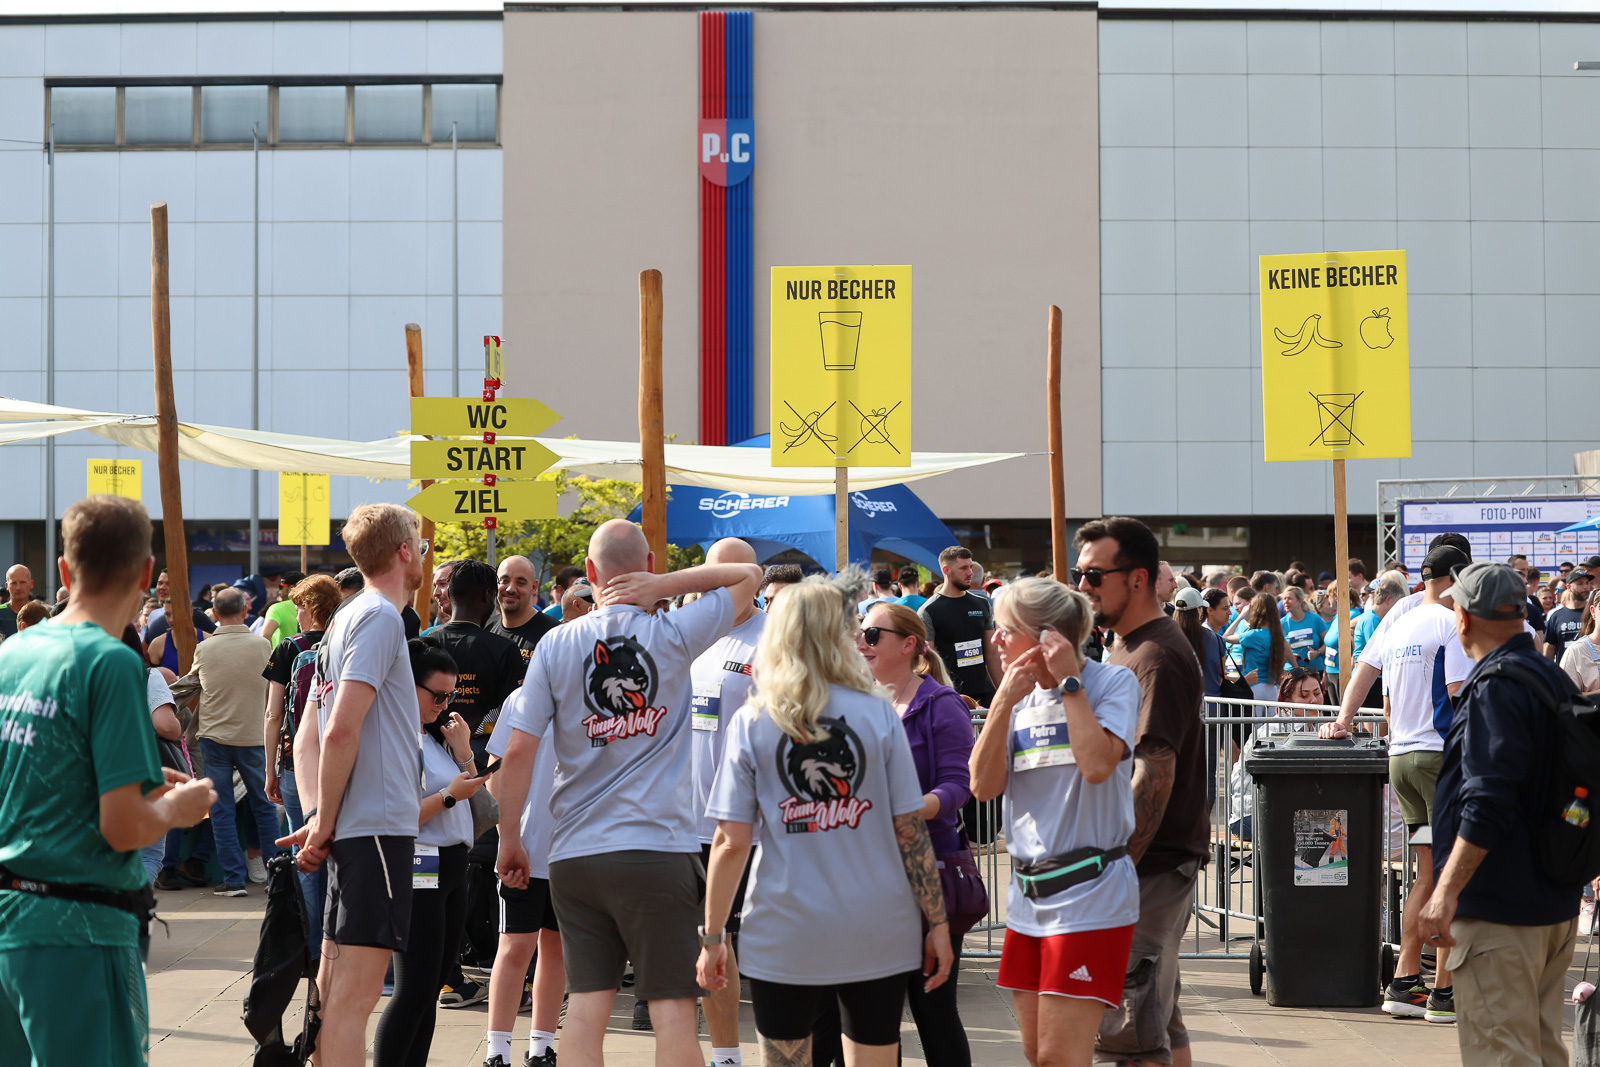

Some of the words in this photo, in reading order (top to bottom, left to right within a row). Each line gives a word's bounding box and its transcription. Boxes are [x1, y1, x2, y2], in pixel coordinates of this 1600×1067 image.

[702, 132, 750, 163] PuC
[1268, 267, 1321, 290] KEINE
[1326, 264, 1398, 288] BECHER
[786, 280, 822, 300] NUR
[827, 279, 896, 300] BECHER
[466, 404, 507, 429] WC
[446, 446, 526, 472] START
[93, 465, 108, 475] NUR
[109, 465, 136, 476] BECHER
[454, 489, 508, 514] ZIEL
[698, 494, 790, 512] SCHERER
[851, 495, 898, 513] SCHERER
[1480, 506, 1543, 521] FOTO-POINT
[964, 648, 980, 657] 4590
[1395, 644, 1422, 659] COMET
[458, 673, 477, 683] your
[455, 685, 480, 697] ojects
[0, 689, 58, 720] undheit
[1029, 725, 1057, 740] Petra
[778, 796, 816, 824] Team
[813, 797, 872, 832] Wolf
